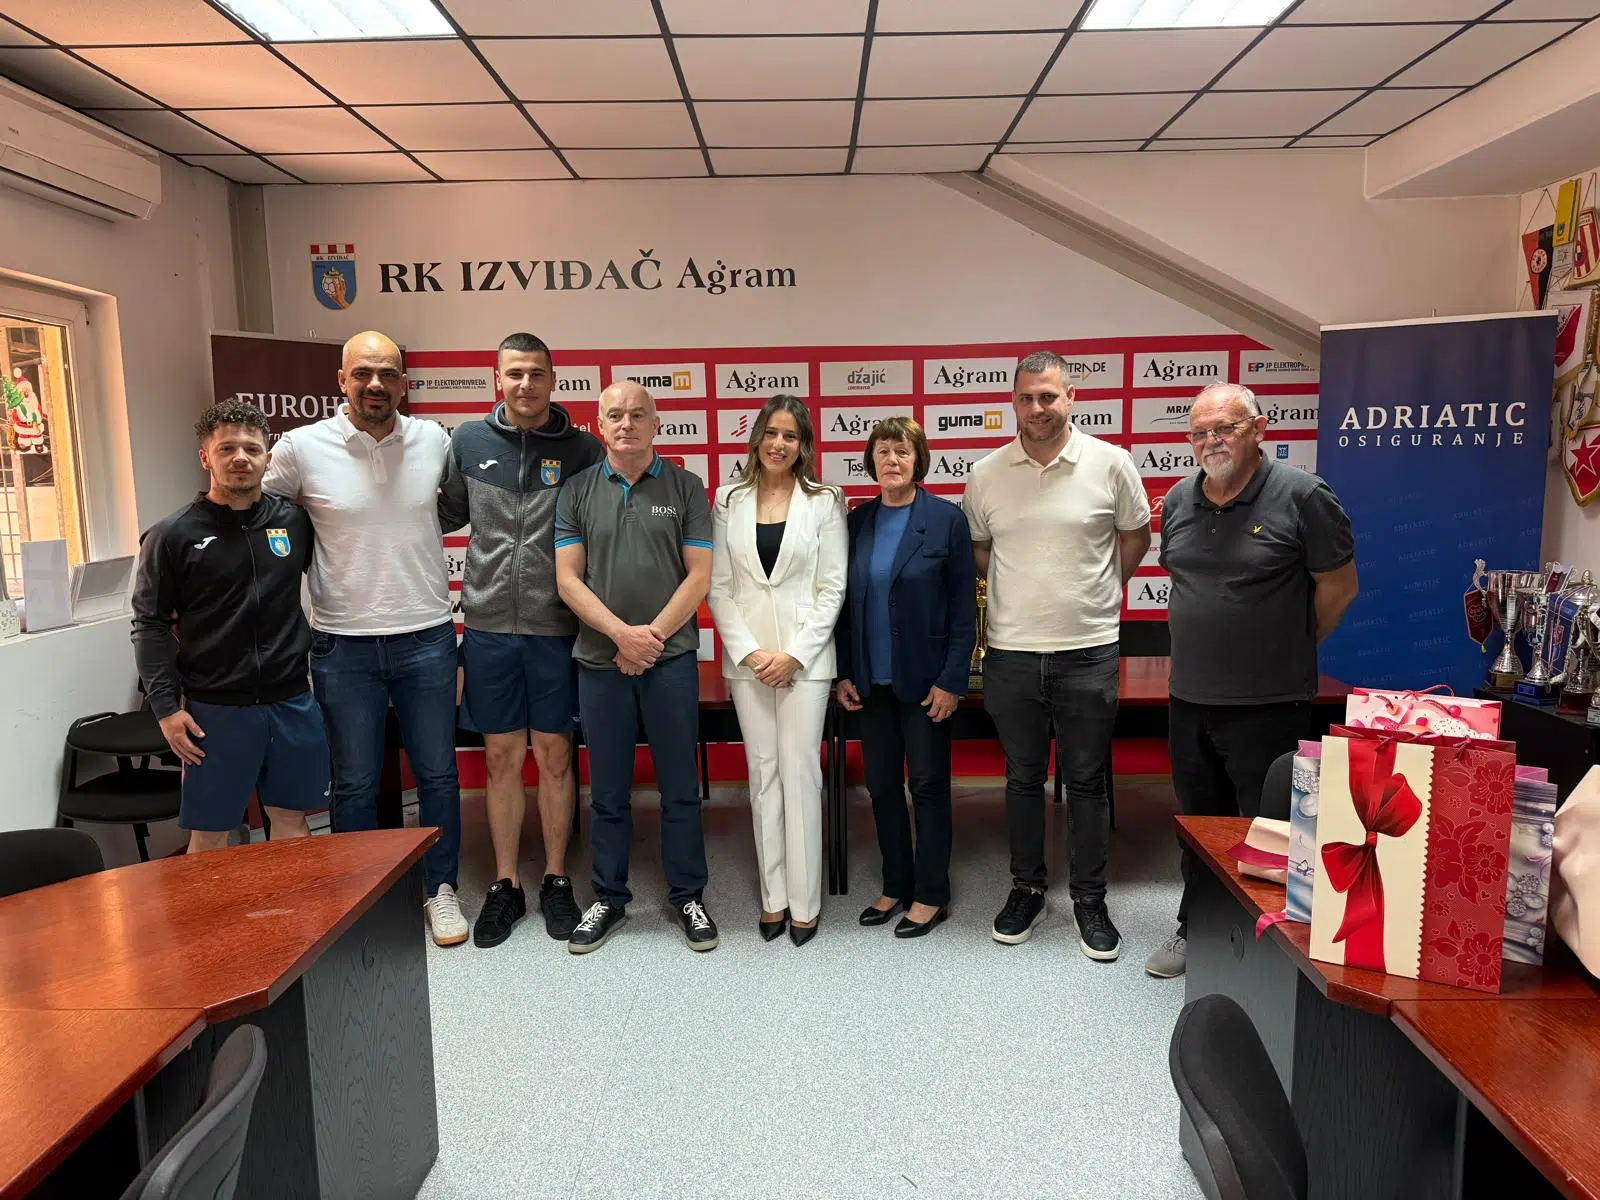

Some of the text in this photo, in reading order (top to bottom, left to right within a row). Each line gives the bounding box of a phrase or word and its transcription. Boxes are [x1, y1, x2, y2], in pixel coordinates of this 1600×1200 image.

[379, 249, 796, 295] RK IZVIĐAČ Agram
[726, 369, 800, 393] Agram
[847, 367, 886, 386] džajić
[933, 365, 1008, 388] Agram
[1143, 358, 1218, 382] Agram
[831, 413, 882, 435] Agra
[1071, 413, 1112, 425] ram
[1339, 402, 1526, 430] ADRIATIC
[657, 422, 697, 436] ram
[1338, 432, 1523, 448] OSIGURANJE
[933, 455, 975, 477] Agr
[1141, 449, 1200, 471] Agra
